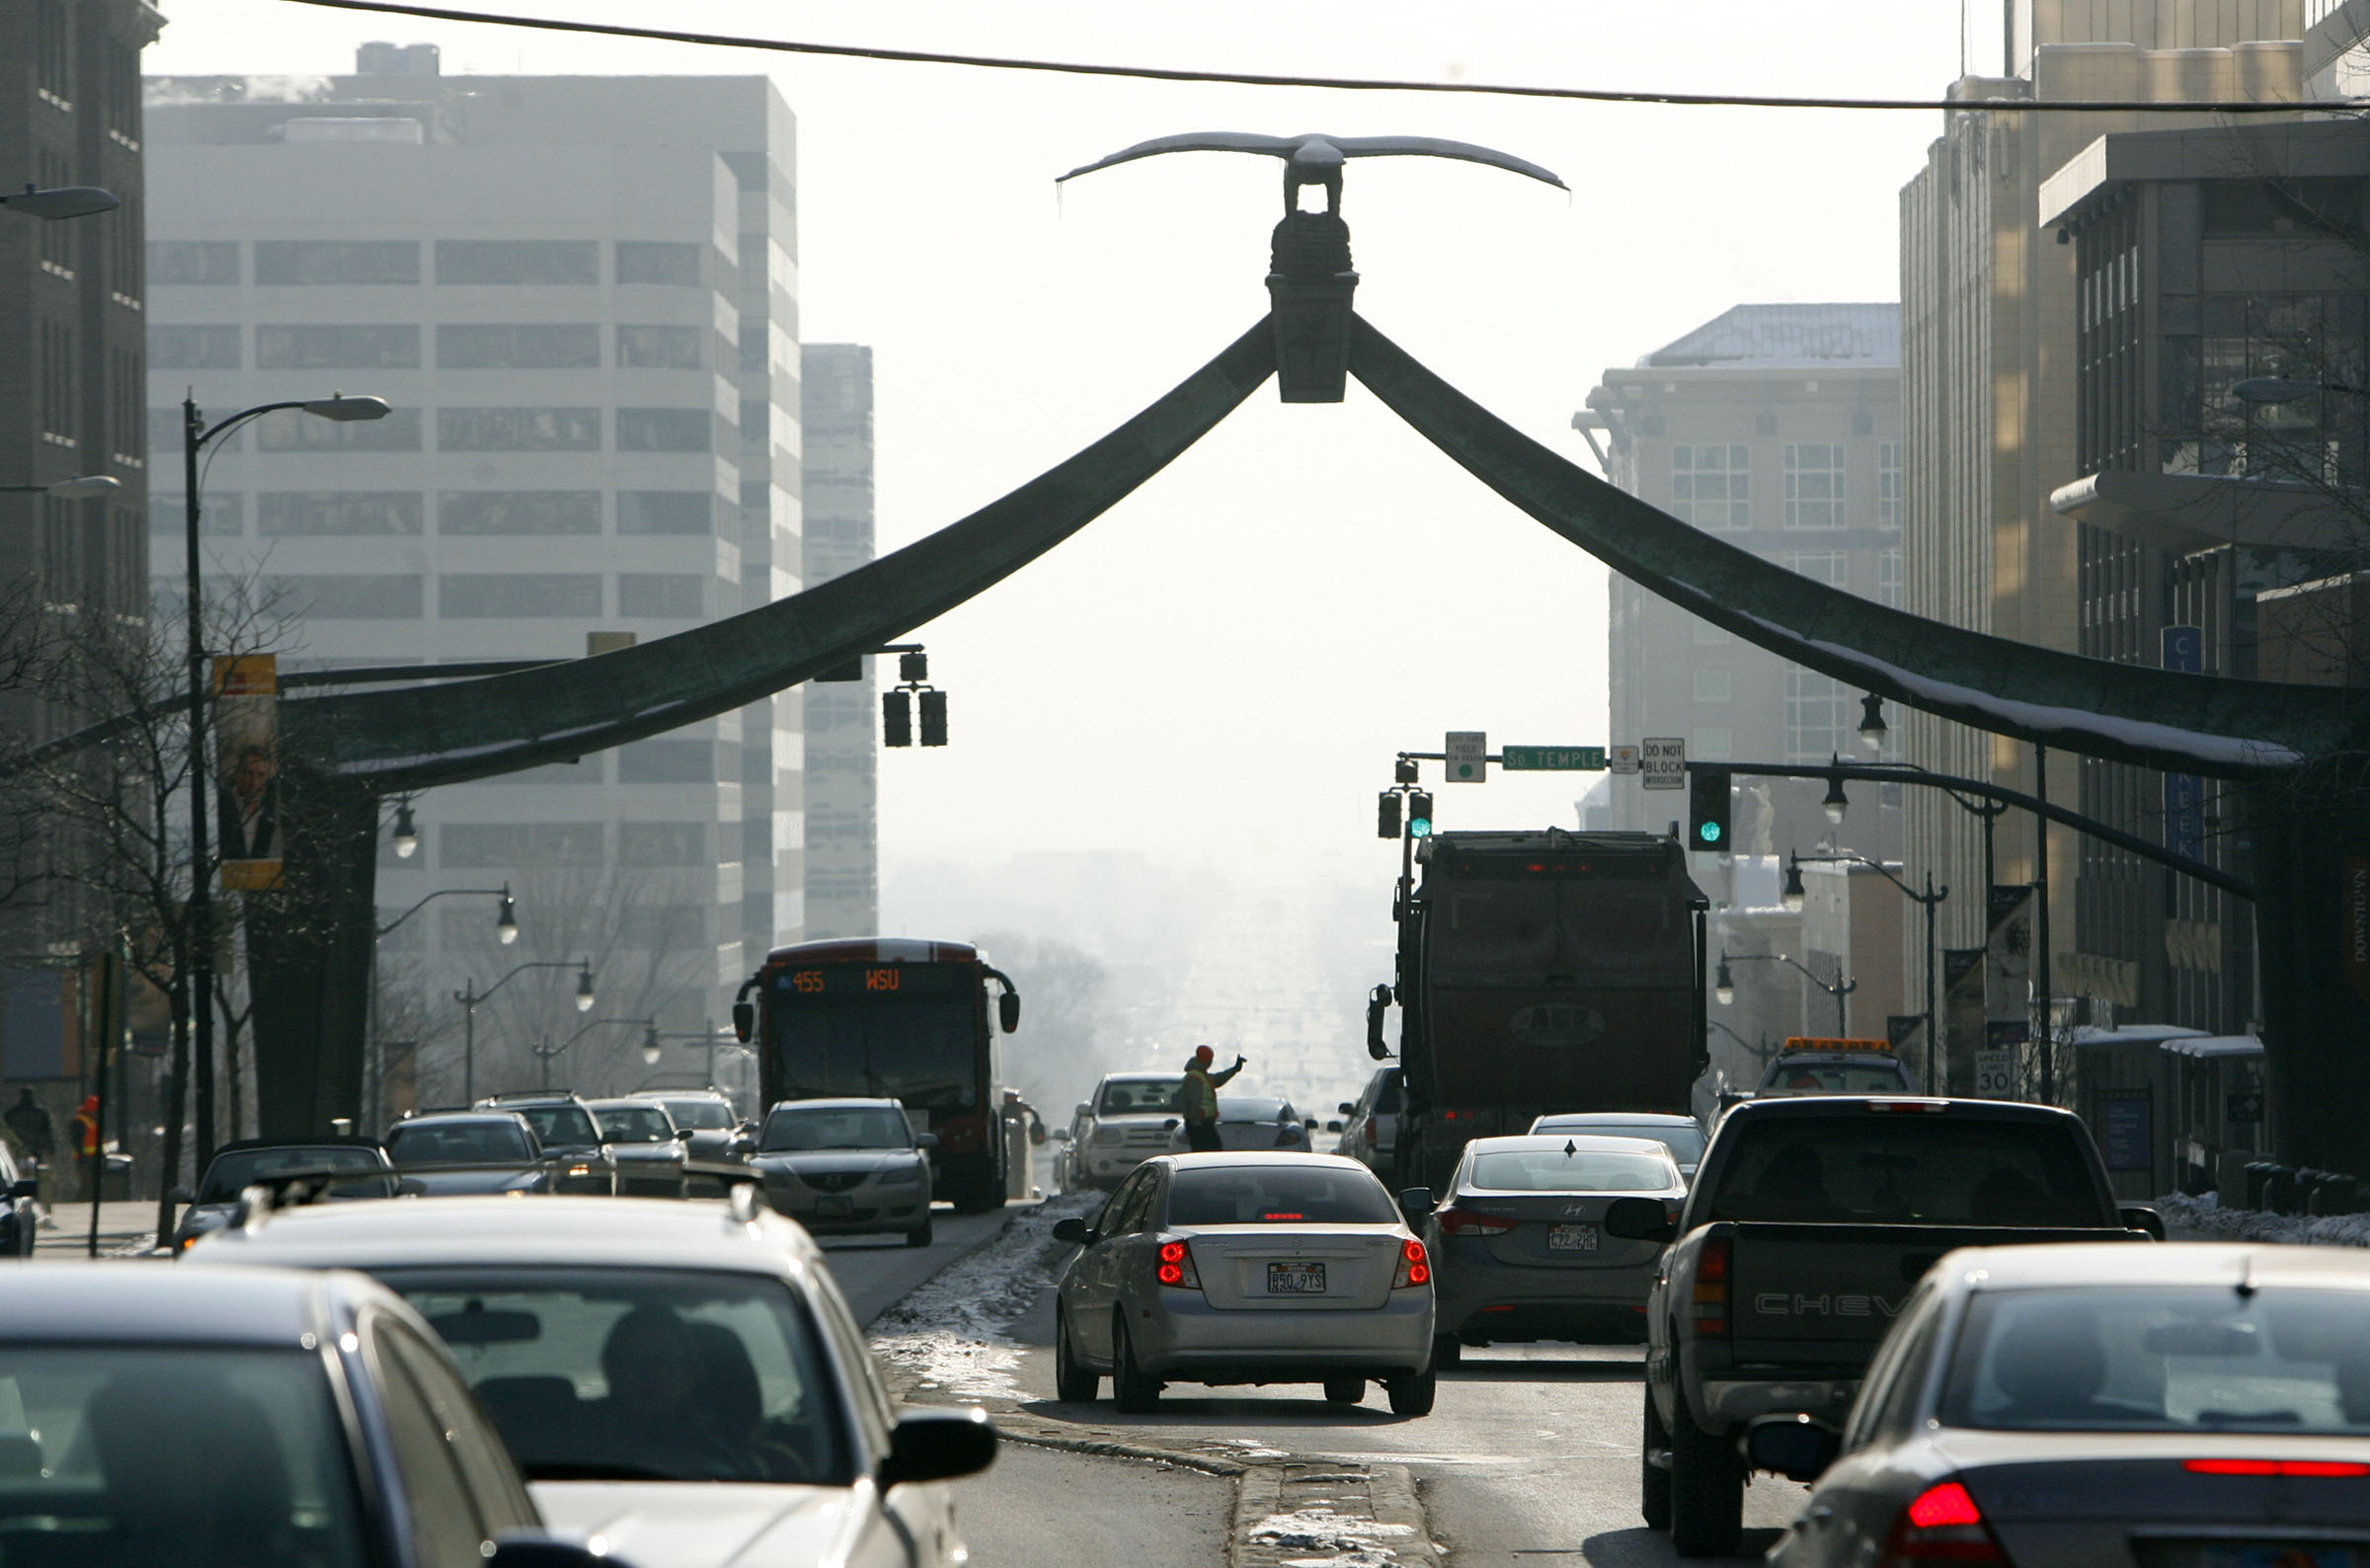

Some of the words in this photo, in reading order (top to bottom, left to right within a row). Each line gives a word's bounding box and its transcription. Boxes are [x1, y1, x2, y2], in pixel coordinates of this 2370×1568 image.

[1537, 750, 1601, 767] TEMPLE
[1646, 745, 1660, 757] DO
[1662, 745, 1683, 757] NOT
[1646, 761, 1683, 774] BLOCK
[2353, 868, 2367, 963] DOWNTOWN
[793, 971, 825, 992] 455
[866, 969, 900, 990] WSU
[1978, 1053, 2009, 1062] SPEED
[1979, 1072, 2009, 1091] 30
